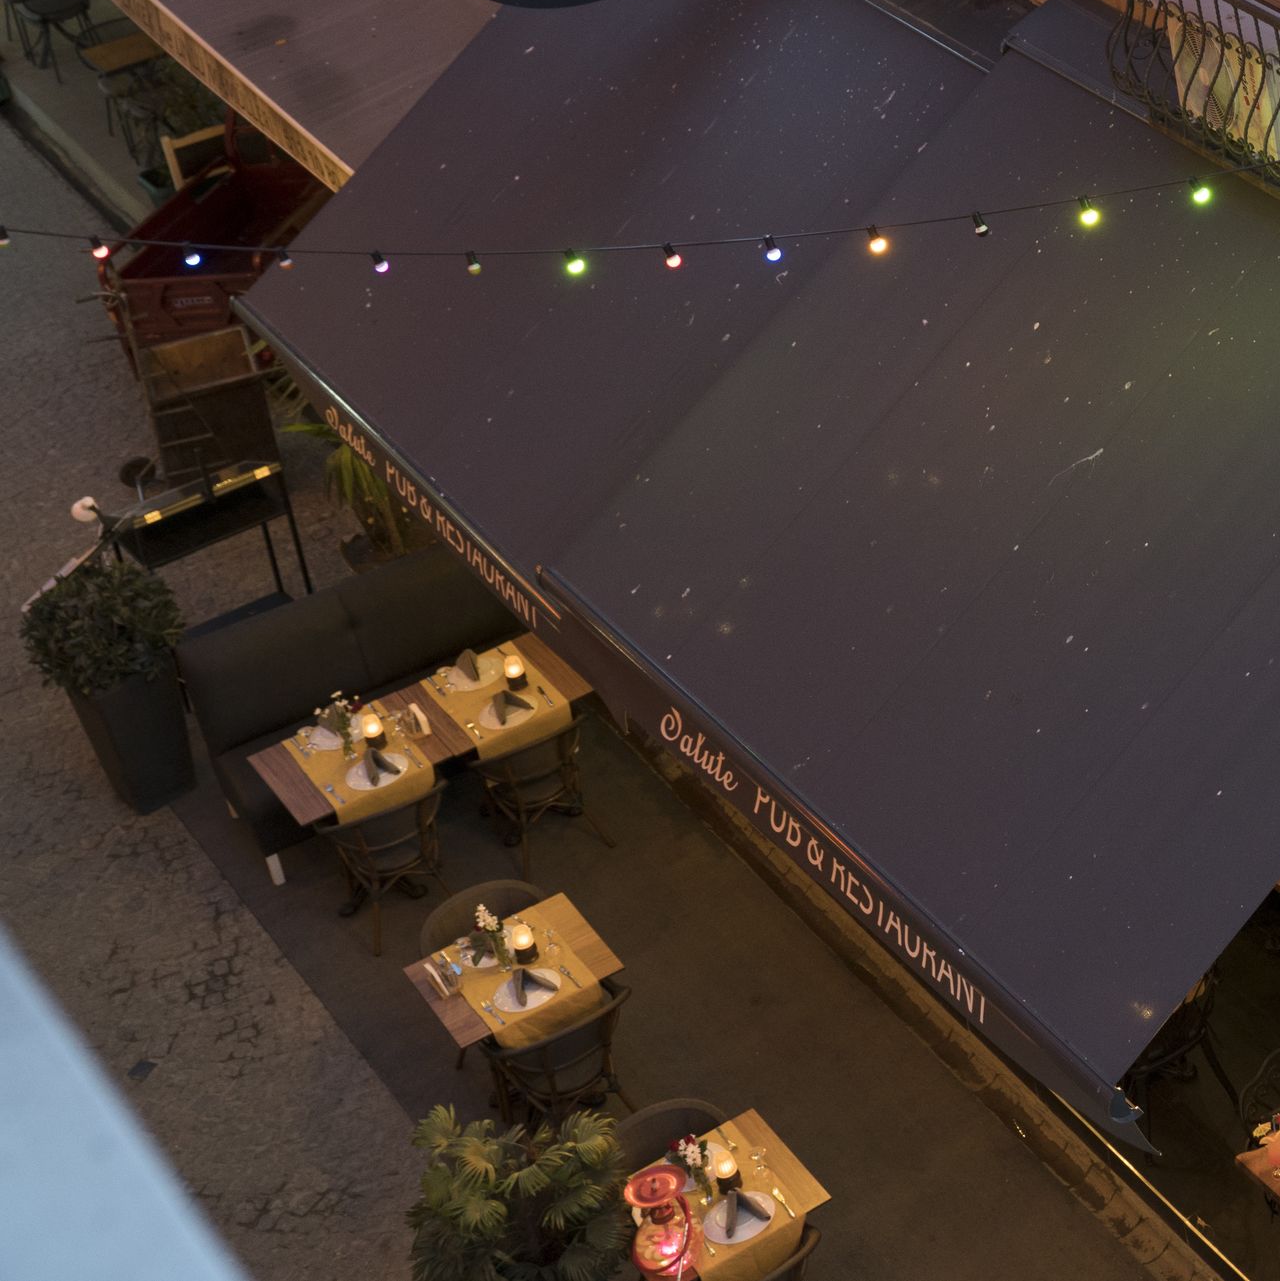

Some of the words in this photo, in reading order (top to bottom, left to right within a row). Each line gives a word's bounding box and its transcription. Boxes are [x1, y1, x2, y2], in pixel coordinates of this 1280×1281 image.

[419, 495, 433, 524] &
[435, 510, 537, 628] RESTAURANT
[752, 785, 802, 848] PUB
[806, 836, 824, 871] &
[830, 856, 986, 1024] RESTAURANT
